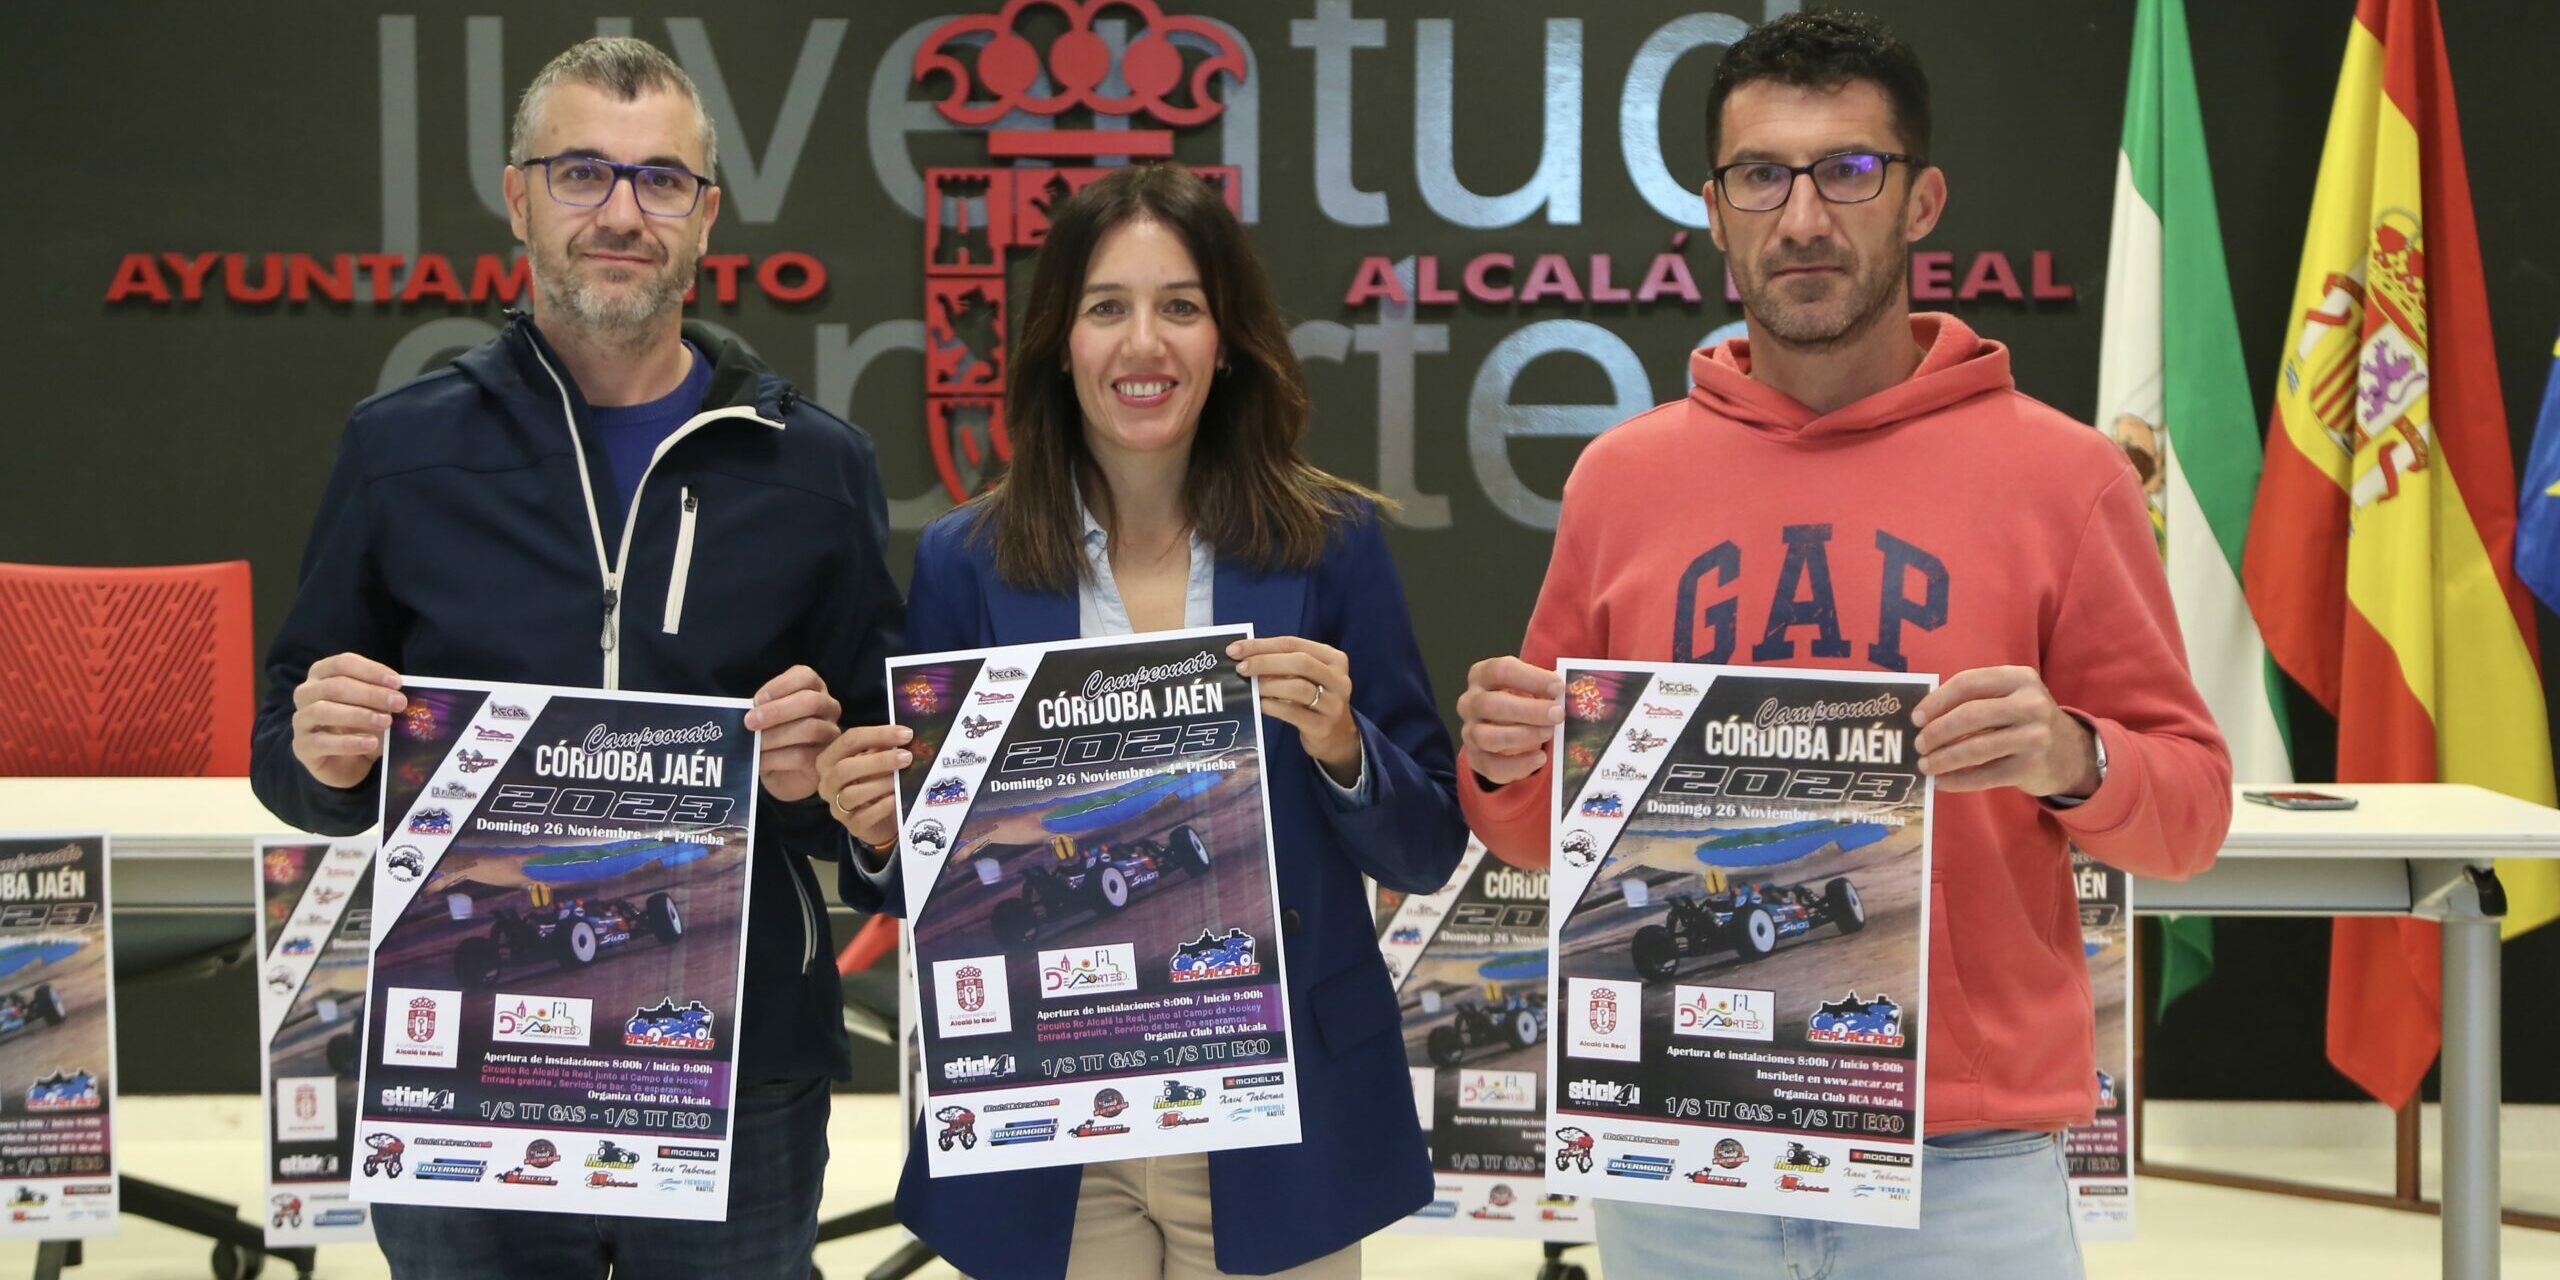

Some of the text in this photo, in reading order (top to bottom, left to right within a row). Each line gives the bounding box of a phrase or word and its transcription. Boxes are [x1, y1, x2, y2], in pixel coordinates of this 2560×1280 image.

[104, 252, 827, 304] AYUNTAMTO
[1346, 230, 1701, 304] ALCALÁ
[1912, 250, 2075, 299] EAL
[1672, 523, 1950, 673] GAP
[1082, 651, 1217, 701] Campeonato
[1038, 691, 1156, 729] CÓRDOBA
[1163, 679, 1223, 718] JAÉN
[1754, 692, 1901, 731] Campeonato
[583, 721, 722, 757] Campeonato
[1001, 720, 1240, 772] 2023
[1705, 715, 1903, 764] CÓRDOBA JAÉN
[535, 739, 723, 788] CÓRDOBA JAÉN
[991, 777, 1052, 792] Domingo
[1058, 773, 1076, 785] 26
[1081, 766, 1153, 782] Noviembre
[1186, 758, 1236, 773] Prueba
[1660, 763, 1916, 804] 2023
[489, 784, 735, 825] 2023
[1647, 800, 1711, 818] Domingo
[1715, 805, 1735, 817] 26
[1740, 806, 1817, 821] Noviembre
[477, 818, 539, 835] Domingo
[544, 823, 563, 835] 26
[568, 824, 640, 839] Noviembre
[675, 833, 724, 846] Prueba
[34, 865, 86, 900] JAÉN
[1485, 867, 1550, 900] CÓRD
[1452, 902, 1549, 930] 20
[1441, 931, 1491, 944] Domingo
[1494, 932, 1509, 944] 26
[1036, 1021, 1071, 1032] Circuito
[1073, 1019, 1084, 1027] Rc
[1116, 1016, 1123, 1024] la
[1149, 1012, 1170, 1022] junto
[1173, 1010, 1181, 1018] al
[1184, 1008, 1214, 1019] Campo
[1216, 1006, 1227, 1014] de
[1037, 991, 1263, 1020] Apertura de instalaciones 8:00h Inicio 9:00h
[1038, 1032, 1071, 1042] Entrada
[1074, 1029, 1107, 1040] gratuita
[1114, 1025, 1149, 1034] Servicio
[1152, 1023, 1163, 1031] de
[1144, 1022, 1267, 1042] Organiza Club RCA Alcala
[484, 1052, 712, 1074] Apertura de instalaciones 8:00h Inicio 9:00h
[1042, 1039, 1270, 1077] 1/8 TT GAS 1/8 TT ECO
[1666, 1045, 1903, 1073] Apertura de instalaciones 8:00h Inicio 9:00h
[481, 1075, 515, 1084] Entrada
[518, 1077, 551, 1087] gratuita
[559, 1079, 594, 1089] Servicio
[596, 1082, 607, 1090] de
[482, 1064, 517, 1074] Circuito
[595, 1071, 617, 1081] junto
[630, 1073, 661, 1084] Campo
[663, 1075, 674, 1083] de
[1235, 1074, 1282, 1085] MODELIX
[1757, 1070, 1904, 1091] Insribete en www.aecar.org
[588, 1090, 711, 1105] Organiza Club RCA Alcala
[1246, 1092, 1285, 1102] Taberna
[1569, 1079, 1640, 1106] stick4u
[1774, 1088, 1903, 1107] Organiza Club RCA Alcala
[480, 1101, 711, 1129] 1/8 TT GAS 1/8 TT ECO
[1453, 1115, 1487, 1125] Apertura
[1666, 1097, 1904, 1133] 1/8 TT GAS 1/8 TT ECO
[994, 1126, 1054, 1138] DIVERMODEL
[670, 1150, 716, 1159] MODELIX
[1611, 1161, 1671, 1174] DIVERMODEL
[1863, 1152, 1912, 1164] MODELIX
[421, 1164, 481, 1175] DIVERMODEL
[679, 1163, 716, 1175] Taberna
